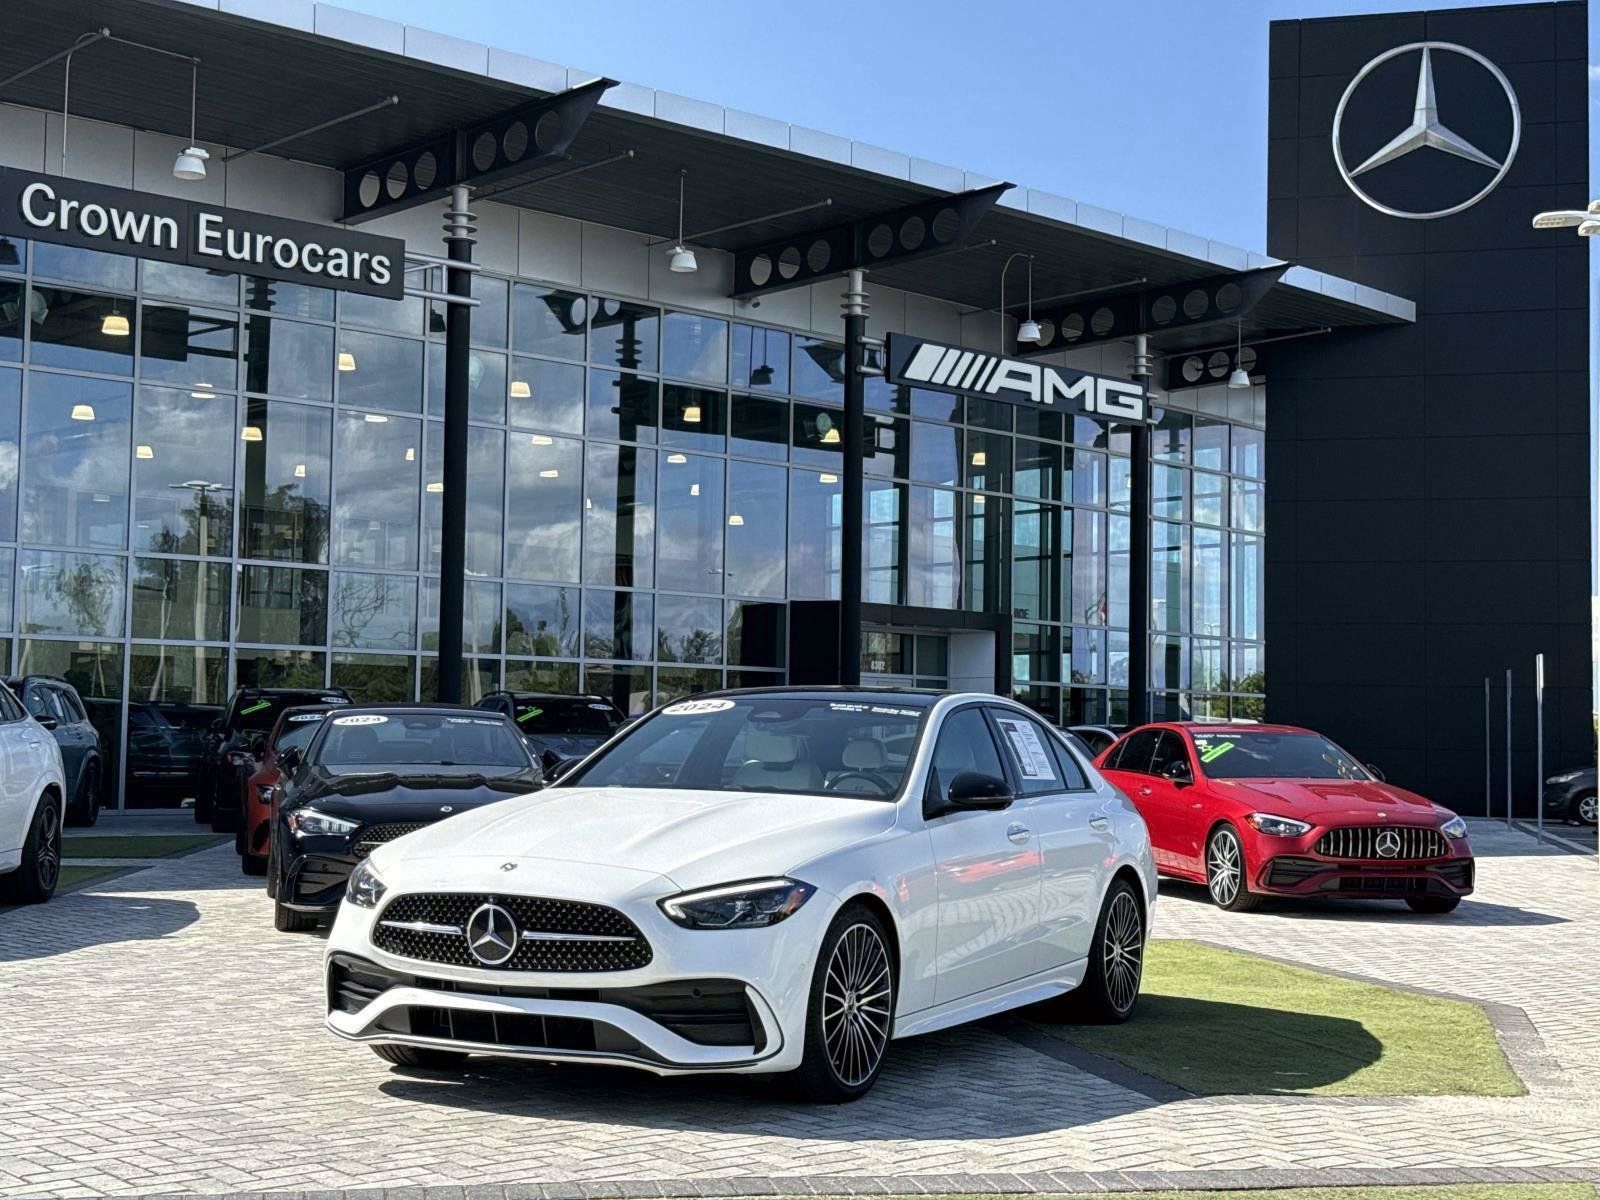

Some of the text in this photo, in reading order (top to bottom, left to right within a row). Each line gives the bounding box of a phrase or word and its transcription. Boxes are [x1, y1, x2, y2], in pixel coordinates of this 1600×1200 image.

[21, 182, 392, 285] Crown Eurocars
[985, 358, 1143, 420] AMG
[668, 702, 727, 712] 2024
